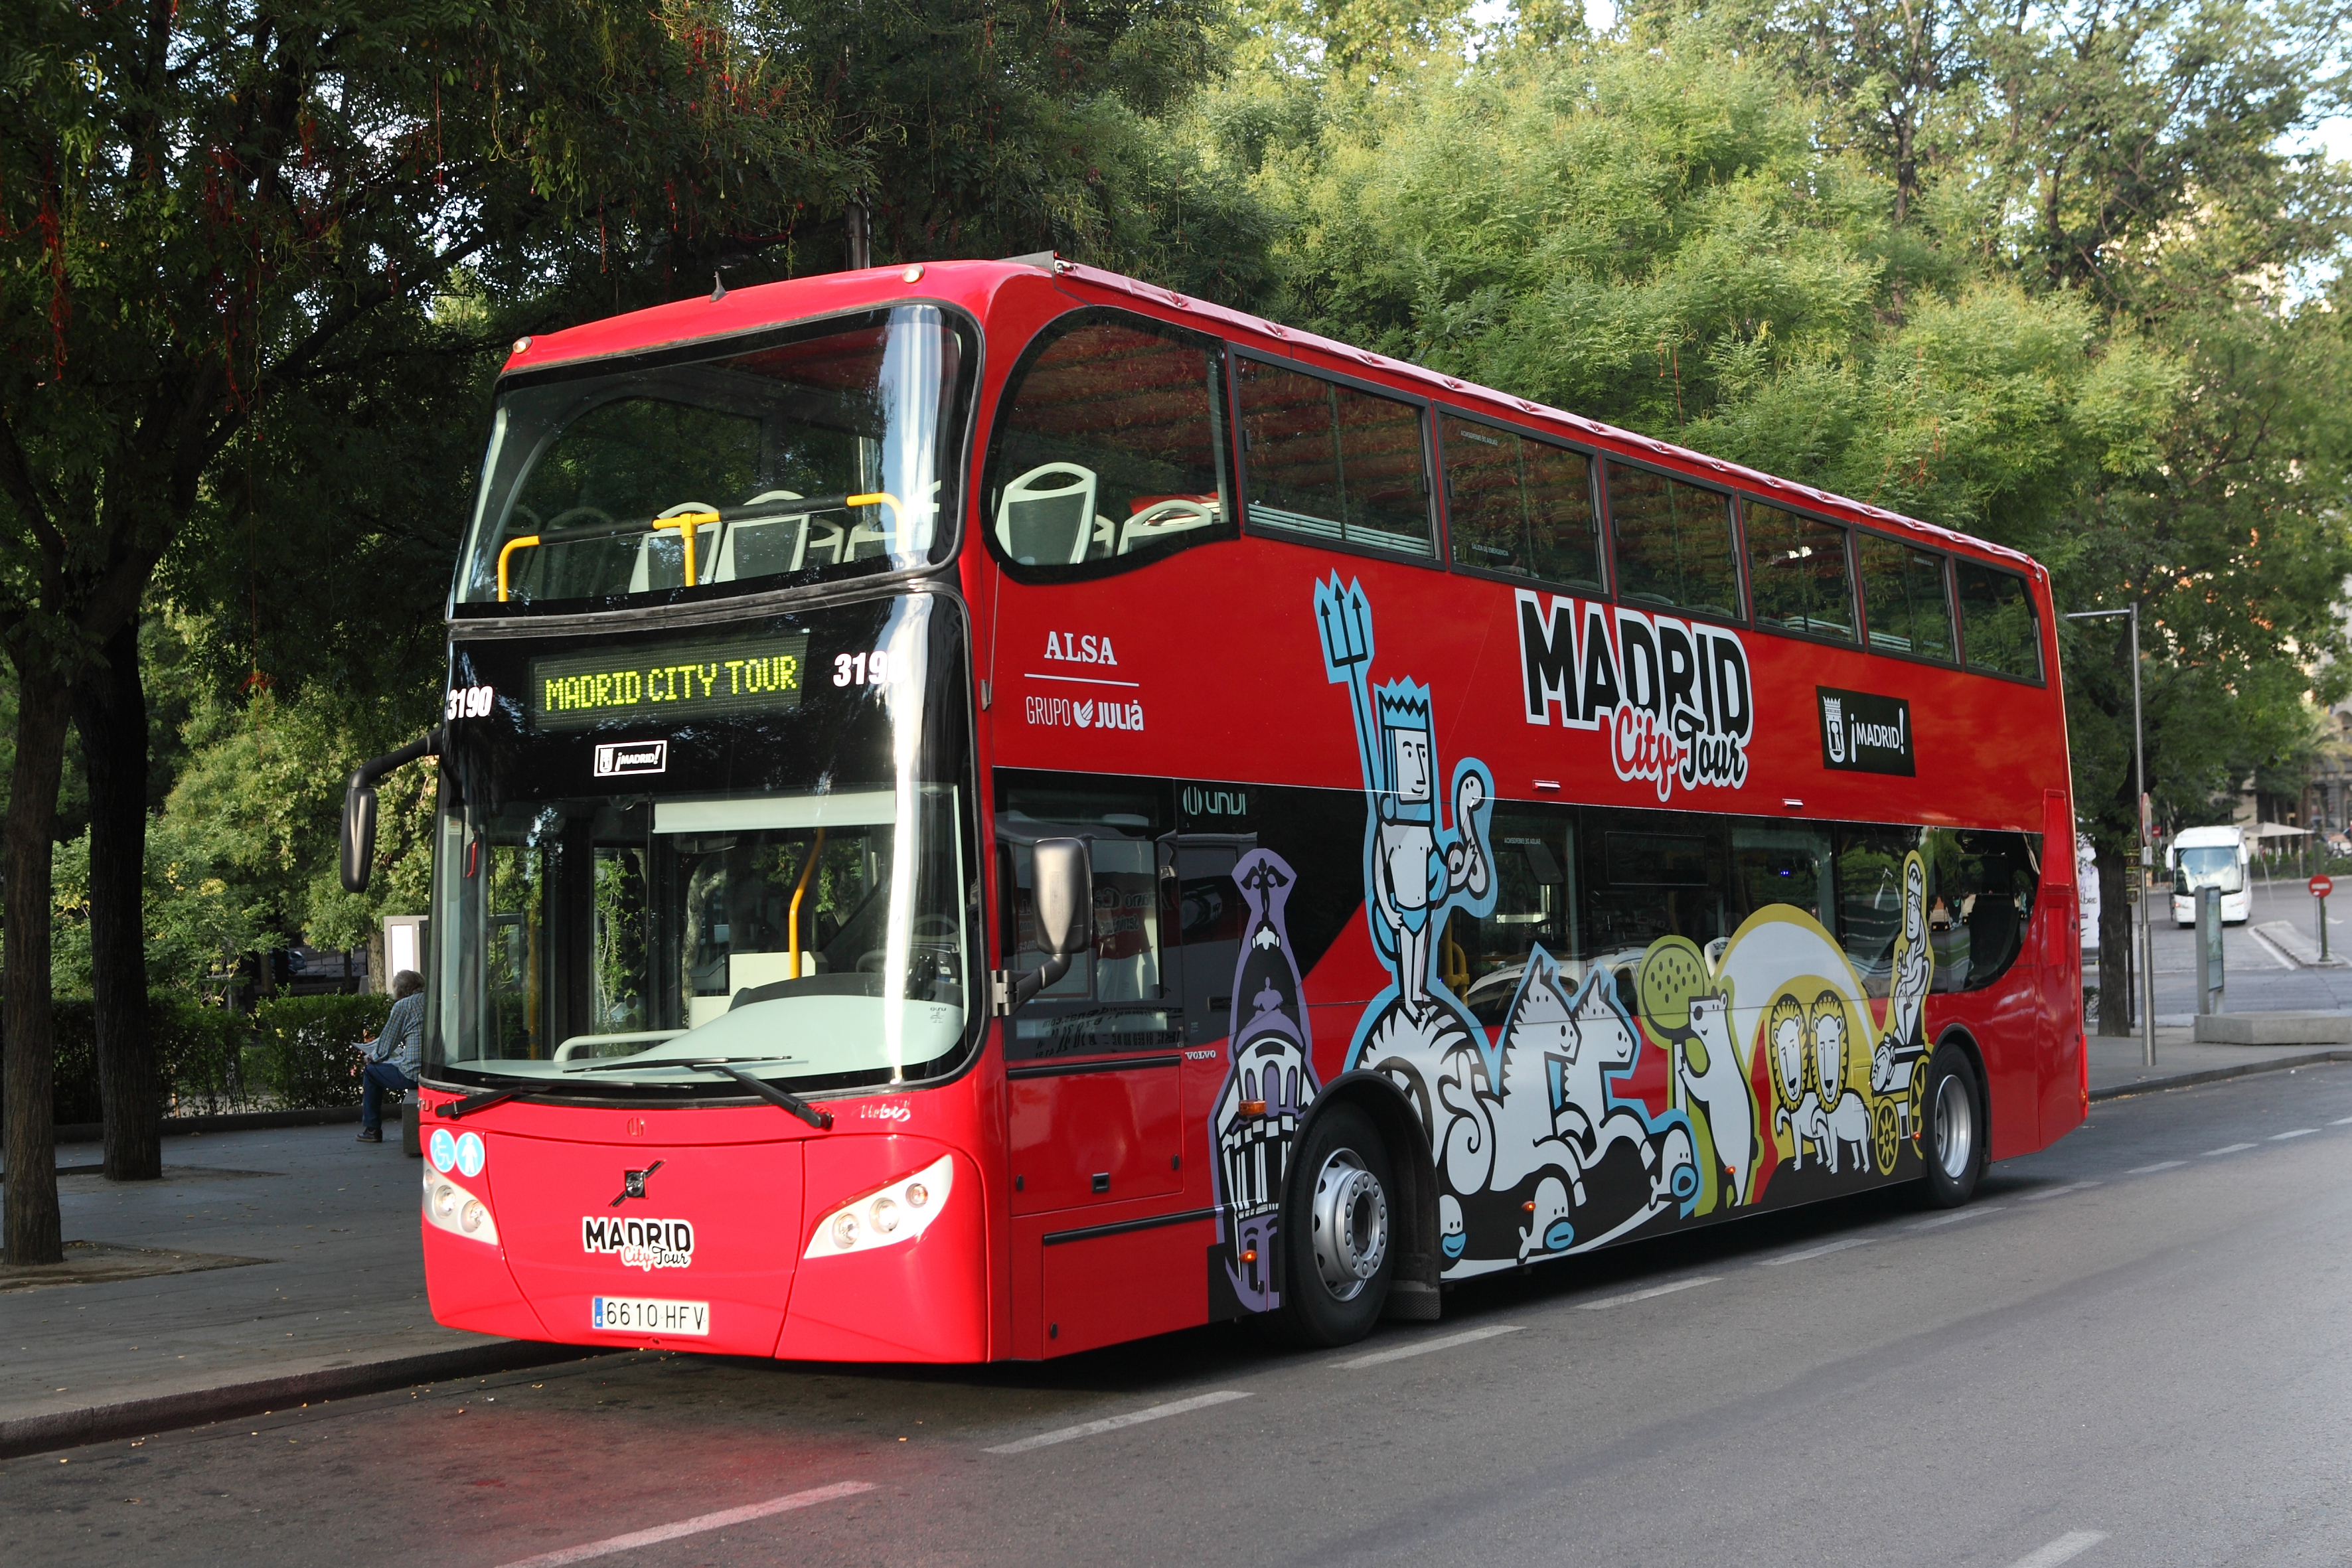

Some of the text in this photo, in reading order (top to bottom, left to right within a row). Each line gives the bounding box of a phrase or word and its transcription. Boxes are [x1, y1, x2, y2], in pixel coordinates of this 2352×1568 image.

[1044, 631, 1118, 665] ALSA
[546, 655, 797, 711] MADRID CITY TOUR
[833, 651, 908, 686] 3190
[1520, 597, 1751, 739] MADRID
[447, 686, 493, 720] 3190
[1026, 696, 1071, 726] GRUPO
[1616, 705, 1745, 795] City Tour
[1184, 1050, 1216, 1060] VOLVO
[586, 1220, 691, 1253] MADRID
[623, 1245, 689, 1268] City Tour
[607, 1302, 657, 1328] 6610
[666, 1304, 704, 1330] HFV
